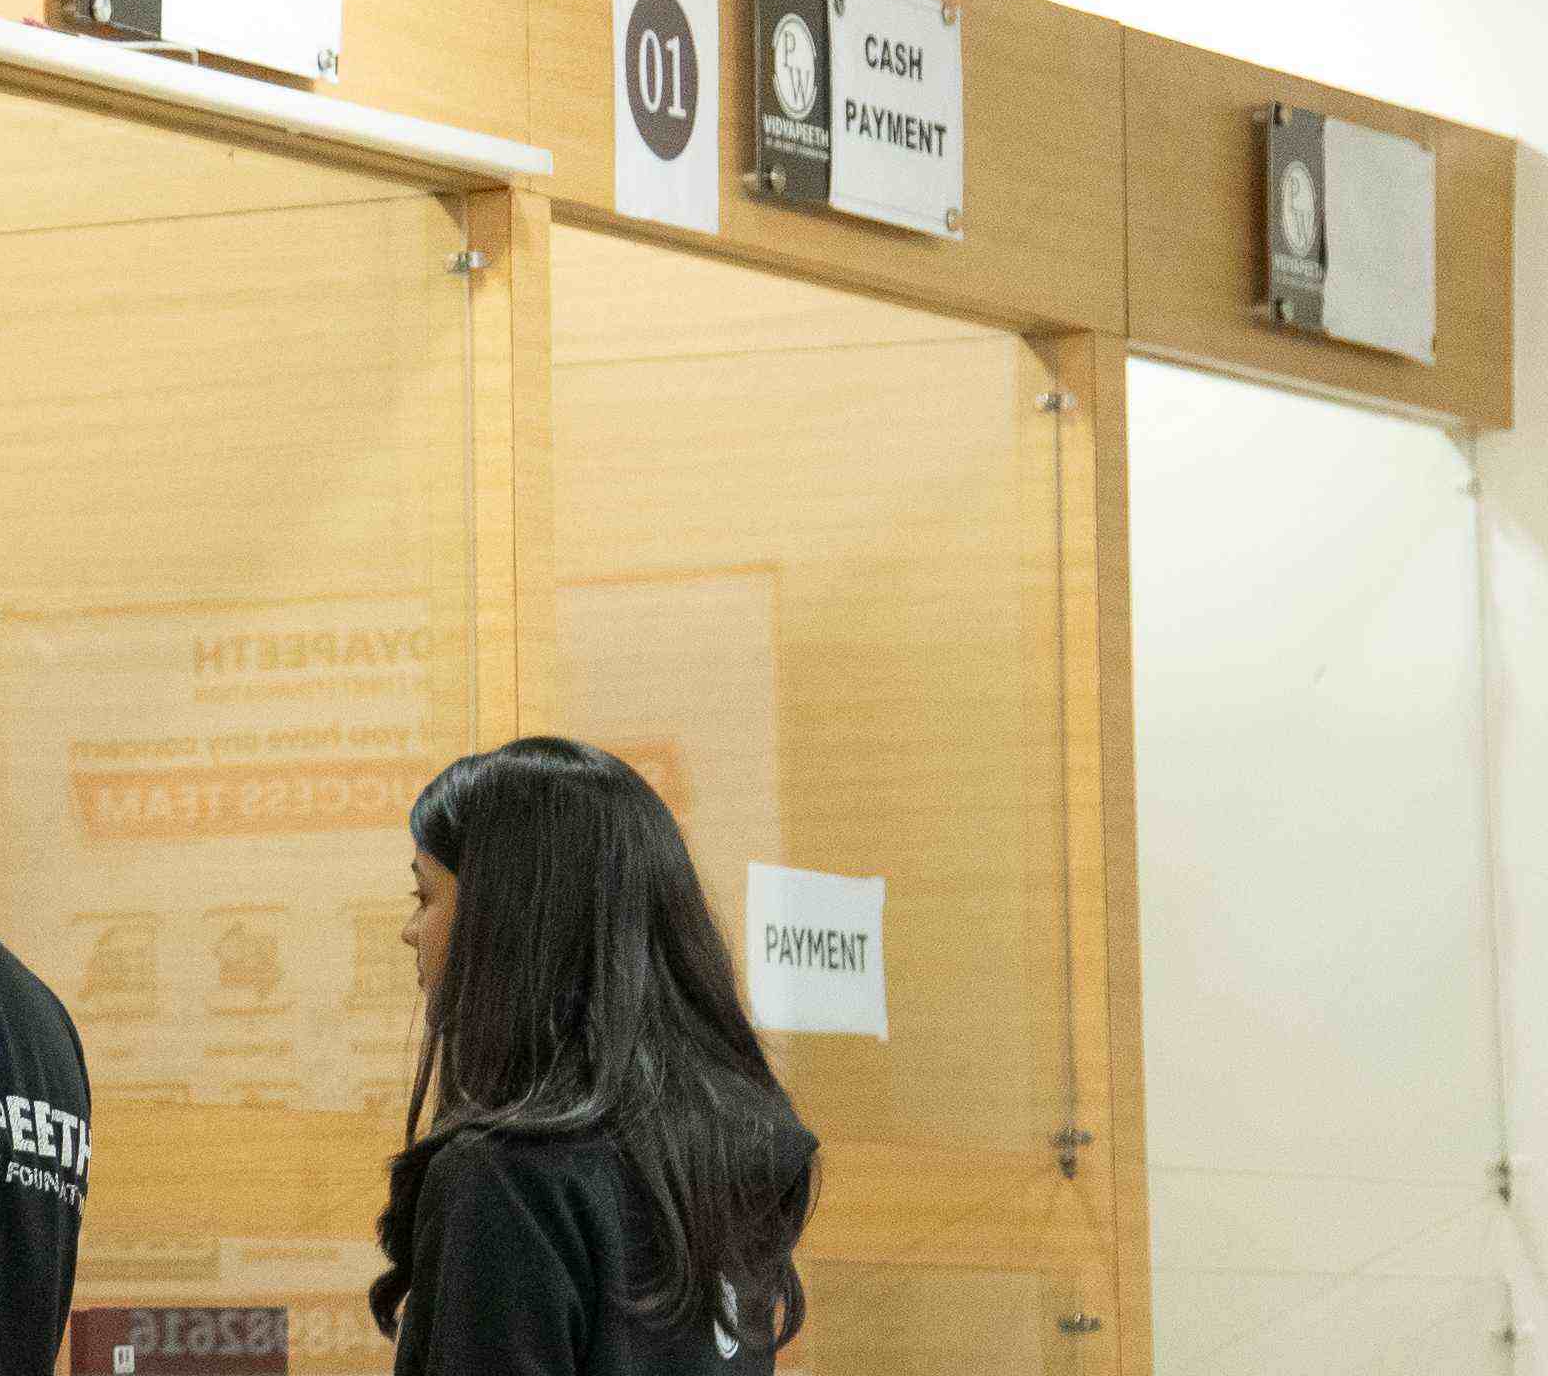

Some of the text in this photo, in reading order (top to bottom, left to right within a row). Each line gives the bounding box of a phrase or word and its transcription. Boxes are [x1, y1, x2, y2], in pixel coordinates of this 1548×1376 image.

[639, 29, 686, 118] 01
[864, 33, 924, 81] CASH
[845, 100, 947, 157] PAYMENT
[765, 923, 868, 972] PAYMENT
